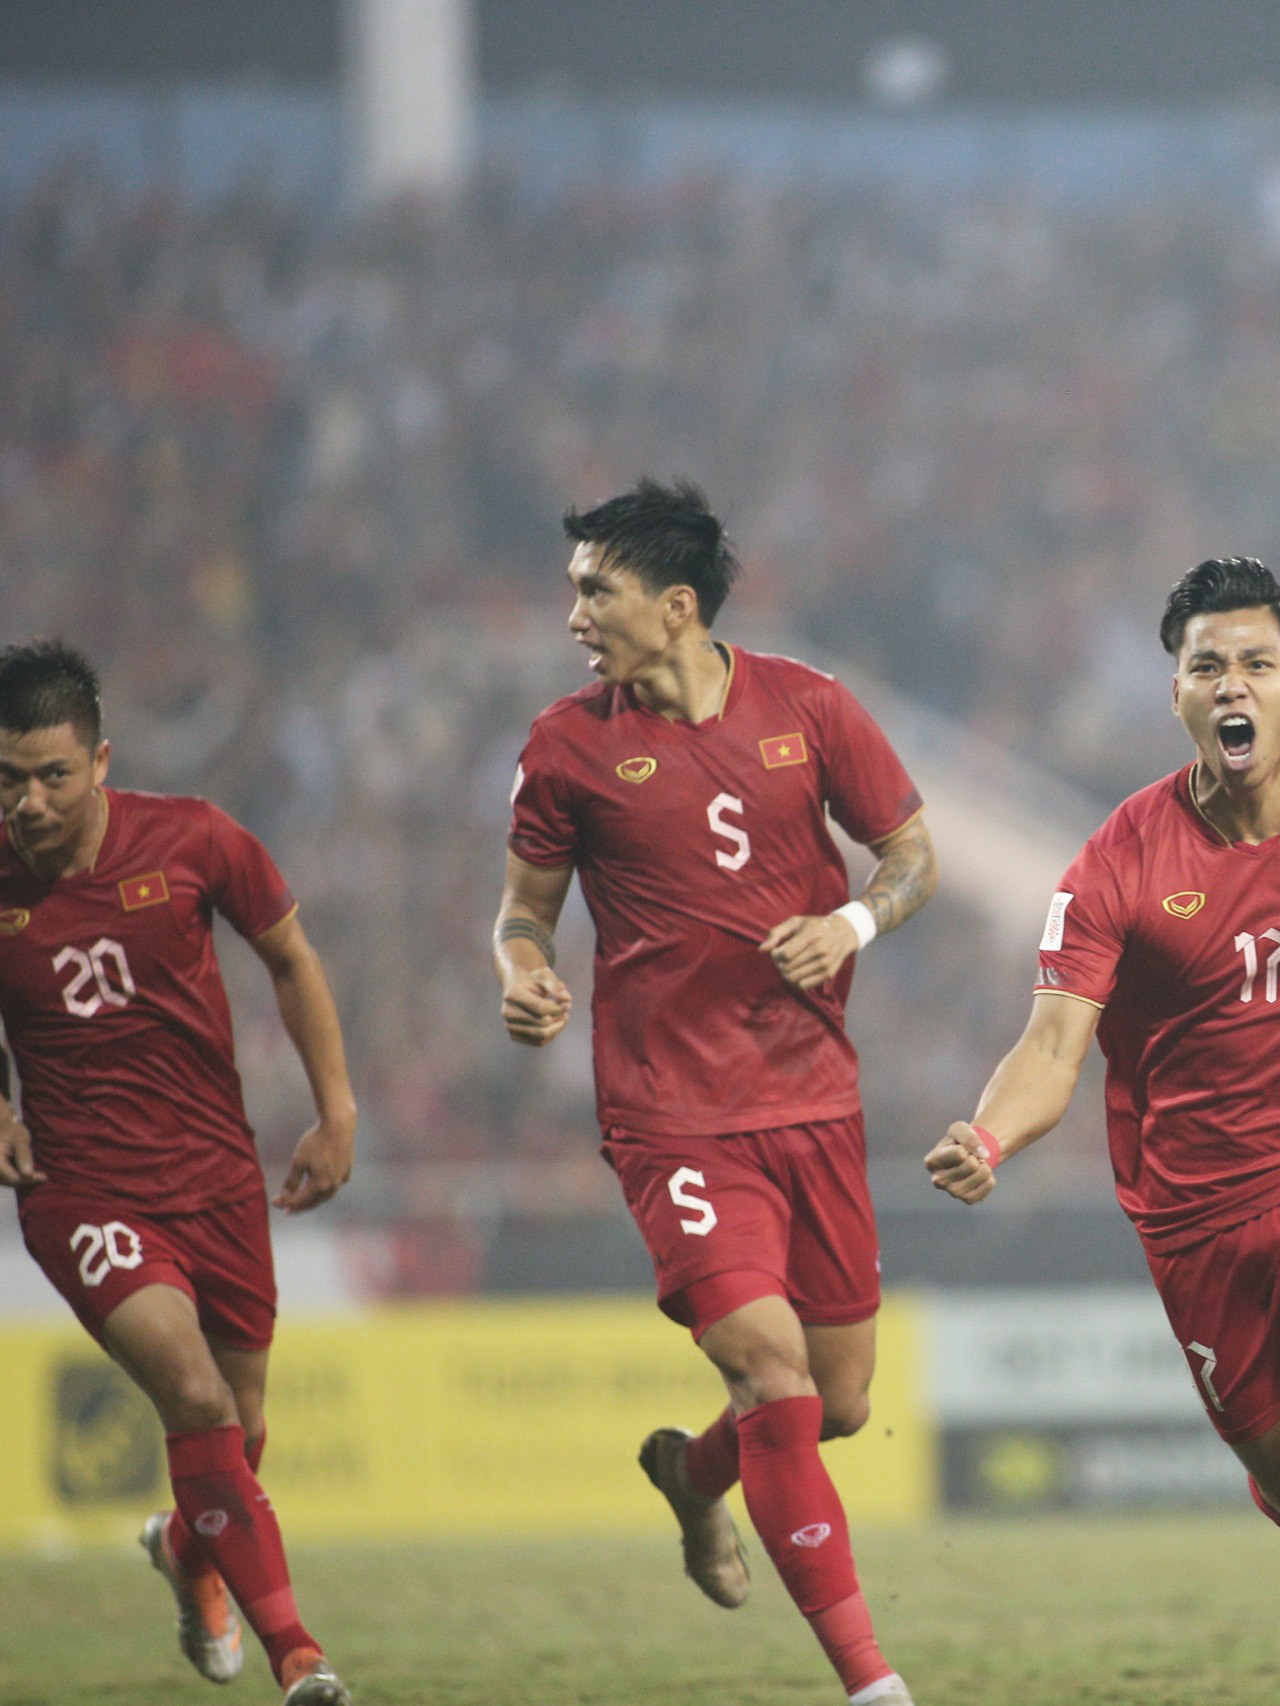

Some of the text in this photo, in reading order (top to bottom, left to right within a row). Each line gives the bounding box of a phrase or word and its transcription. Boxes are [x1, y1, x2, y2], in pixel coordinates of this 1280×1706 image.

[52, 938, 136, 1018] 20
[70, 1220, 144, 1288] 20
[1180, 1340, 1225, 1412] 7
